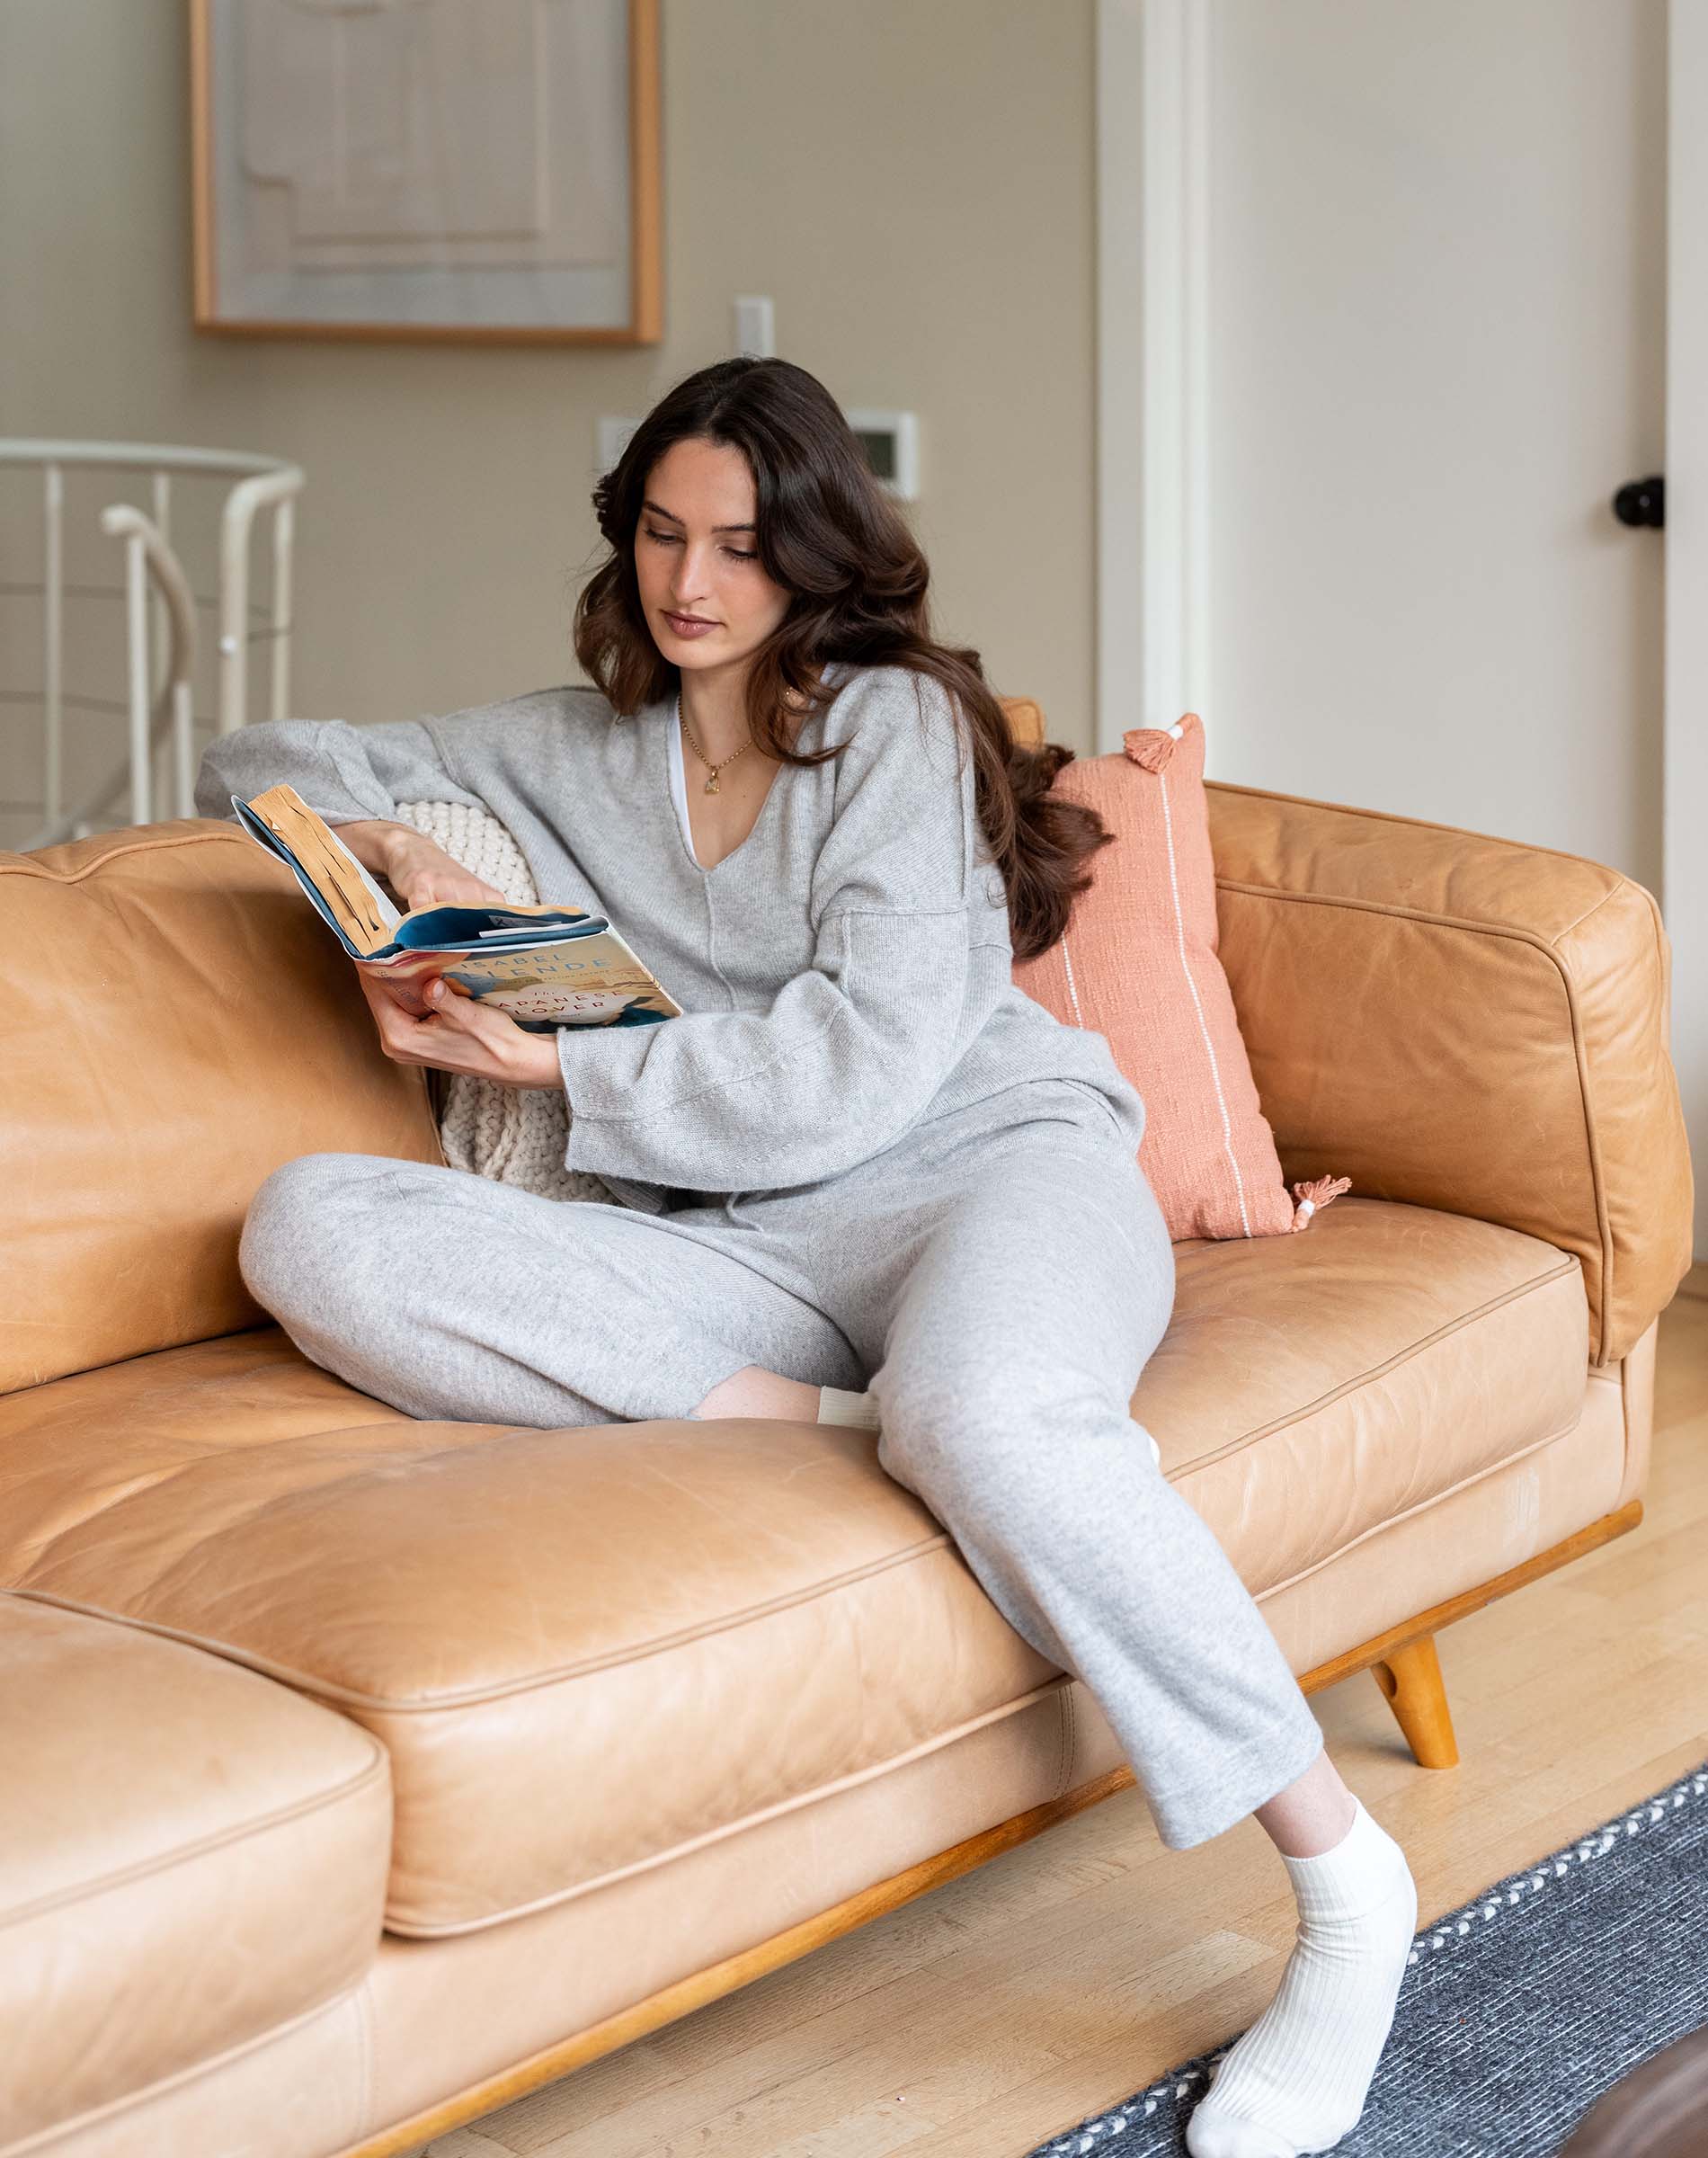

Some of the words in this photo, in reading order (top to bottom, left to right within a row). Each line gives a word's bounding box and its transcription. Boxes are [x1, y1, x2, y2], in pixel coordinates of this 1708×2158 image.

[460, 953, 568, 969] ISABEL
[462, 959, 612, 980] LLENDE
[514, 1002, 605, 1015] LOVER
